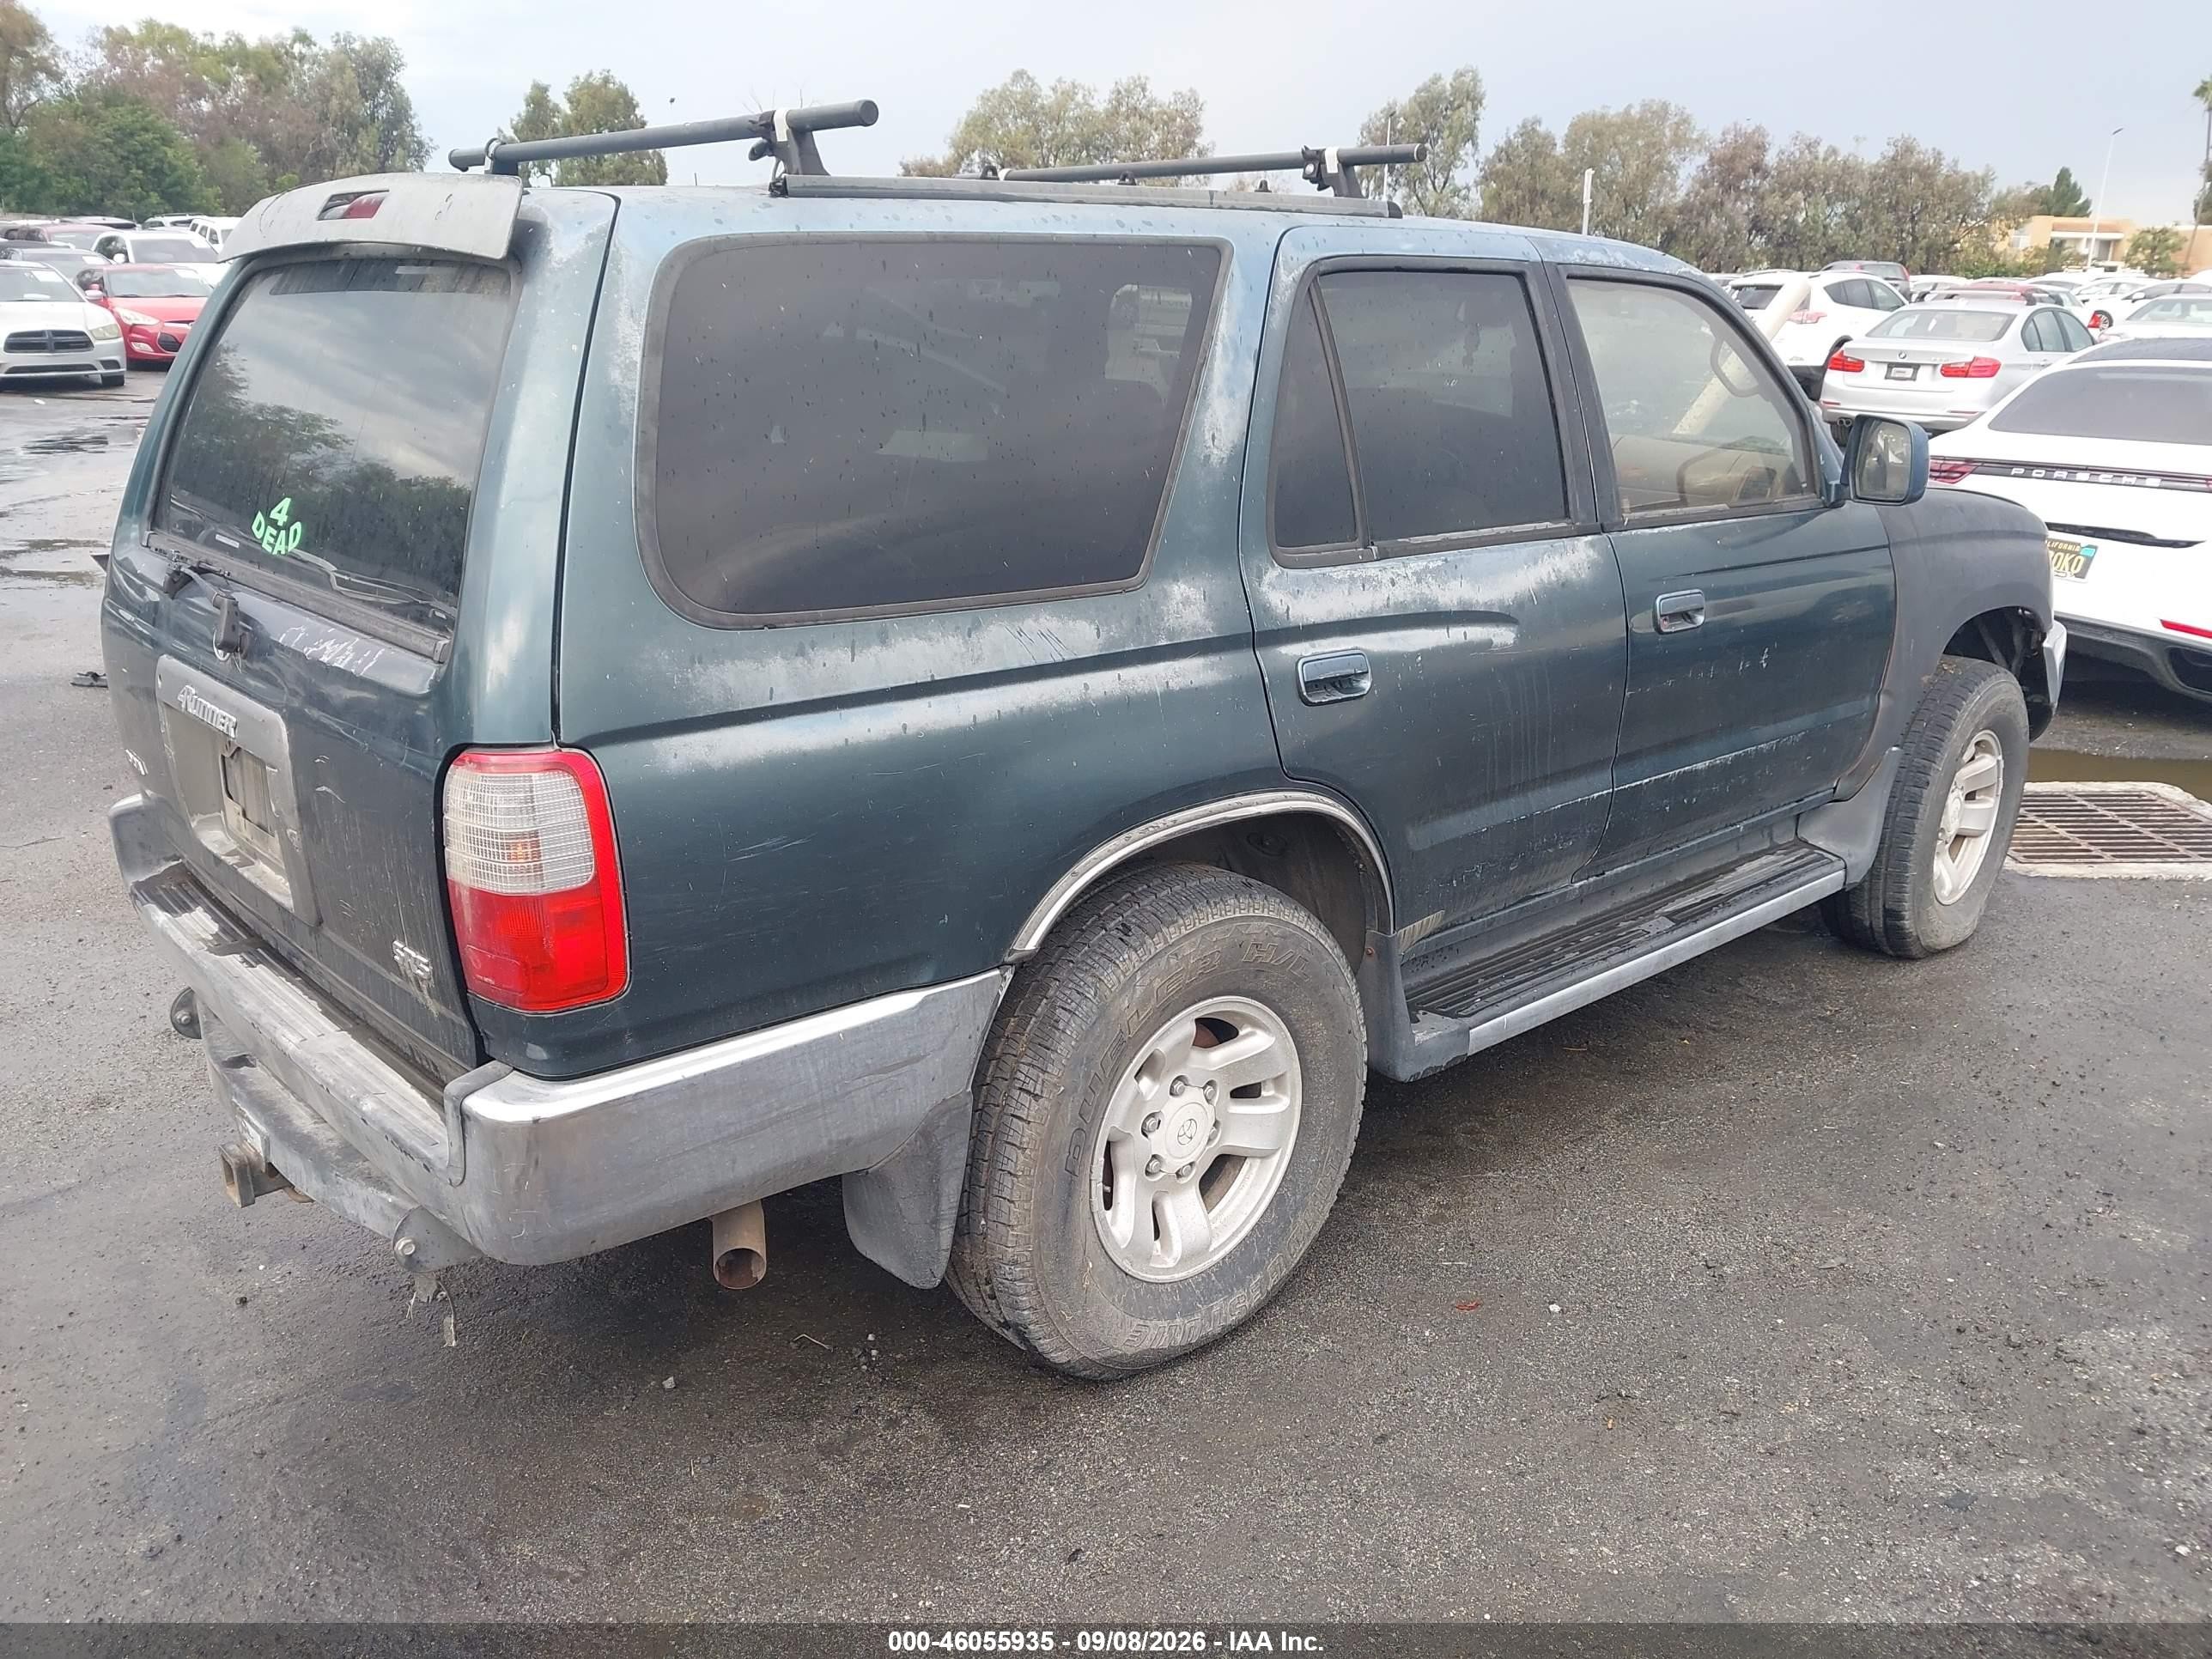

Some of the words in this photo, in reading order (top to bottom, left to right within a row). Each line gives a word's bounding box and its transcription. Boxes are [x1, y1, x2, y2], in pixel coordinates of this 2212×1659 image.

[2010, 467, 2163, 488] PORSCHE
[269, 496, 292, 526] 4
[252, 510, 302, 555] DEAD
[2047, 541, 2081, 551] LIFORNIA
